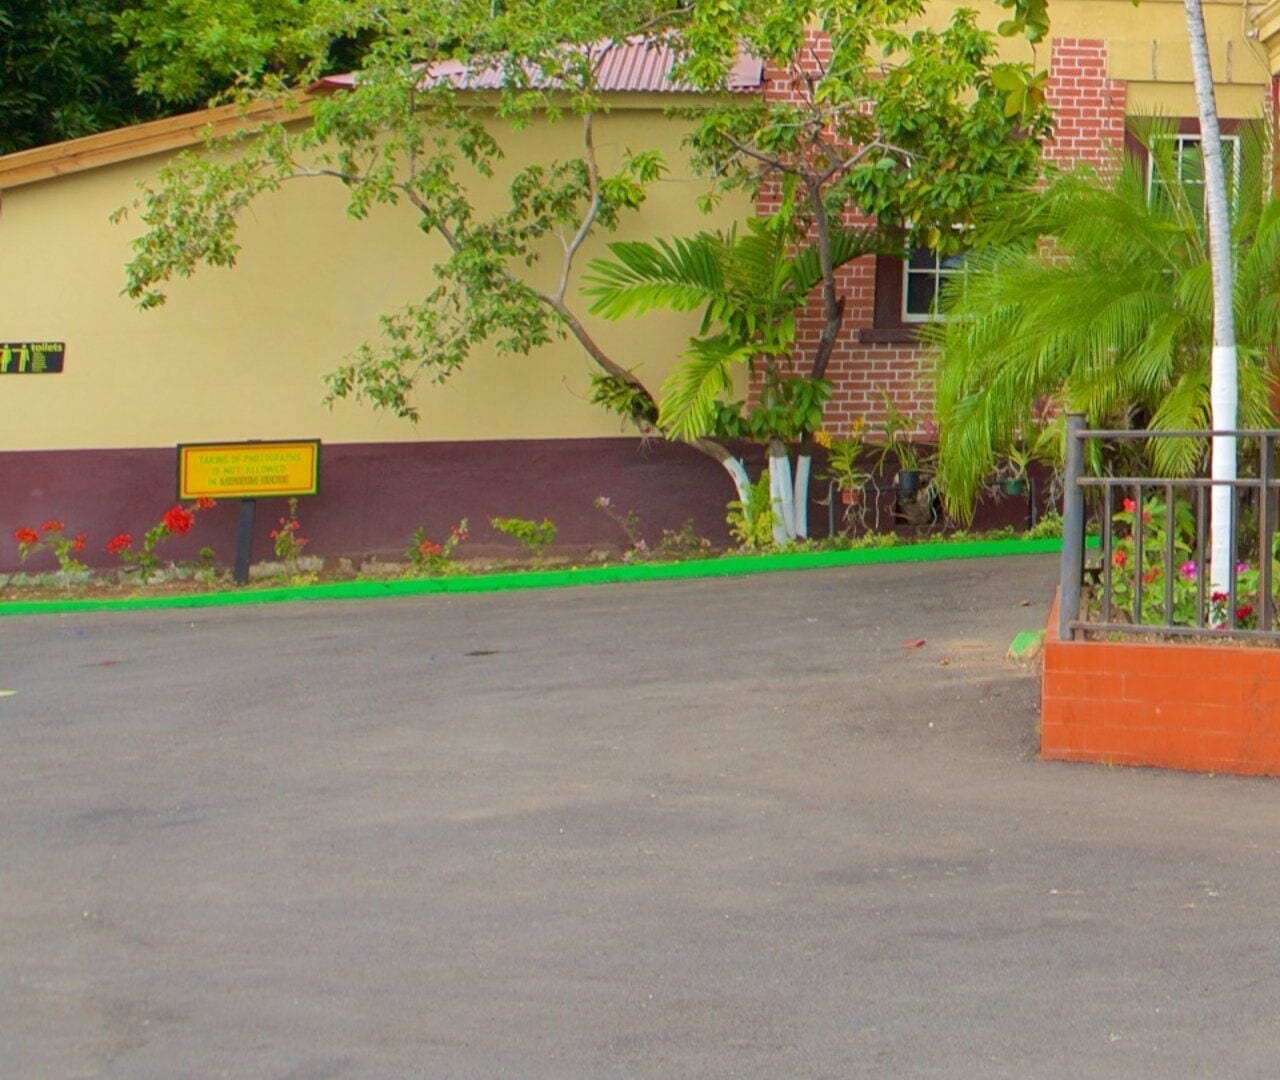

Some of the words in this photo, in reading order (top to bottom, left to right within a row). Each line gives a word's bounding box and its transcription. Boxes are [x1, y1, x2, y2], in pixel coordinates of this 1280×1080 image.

[30, 342, 62, 353] toilets
[198, 455, 228, 465] TAKING
[231, 454, 240, 463] OF
[243, 452, 301, 463] PHOTOGRAPHS
[223, 466, 240, 474] NOT
[245, 464, 286, 474] ALLOWED
